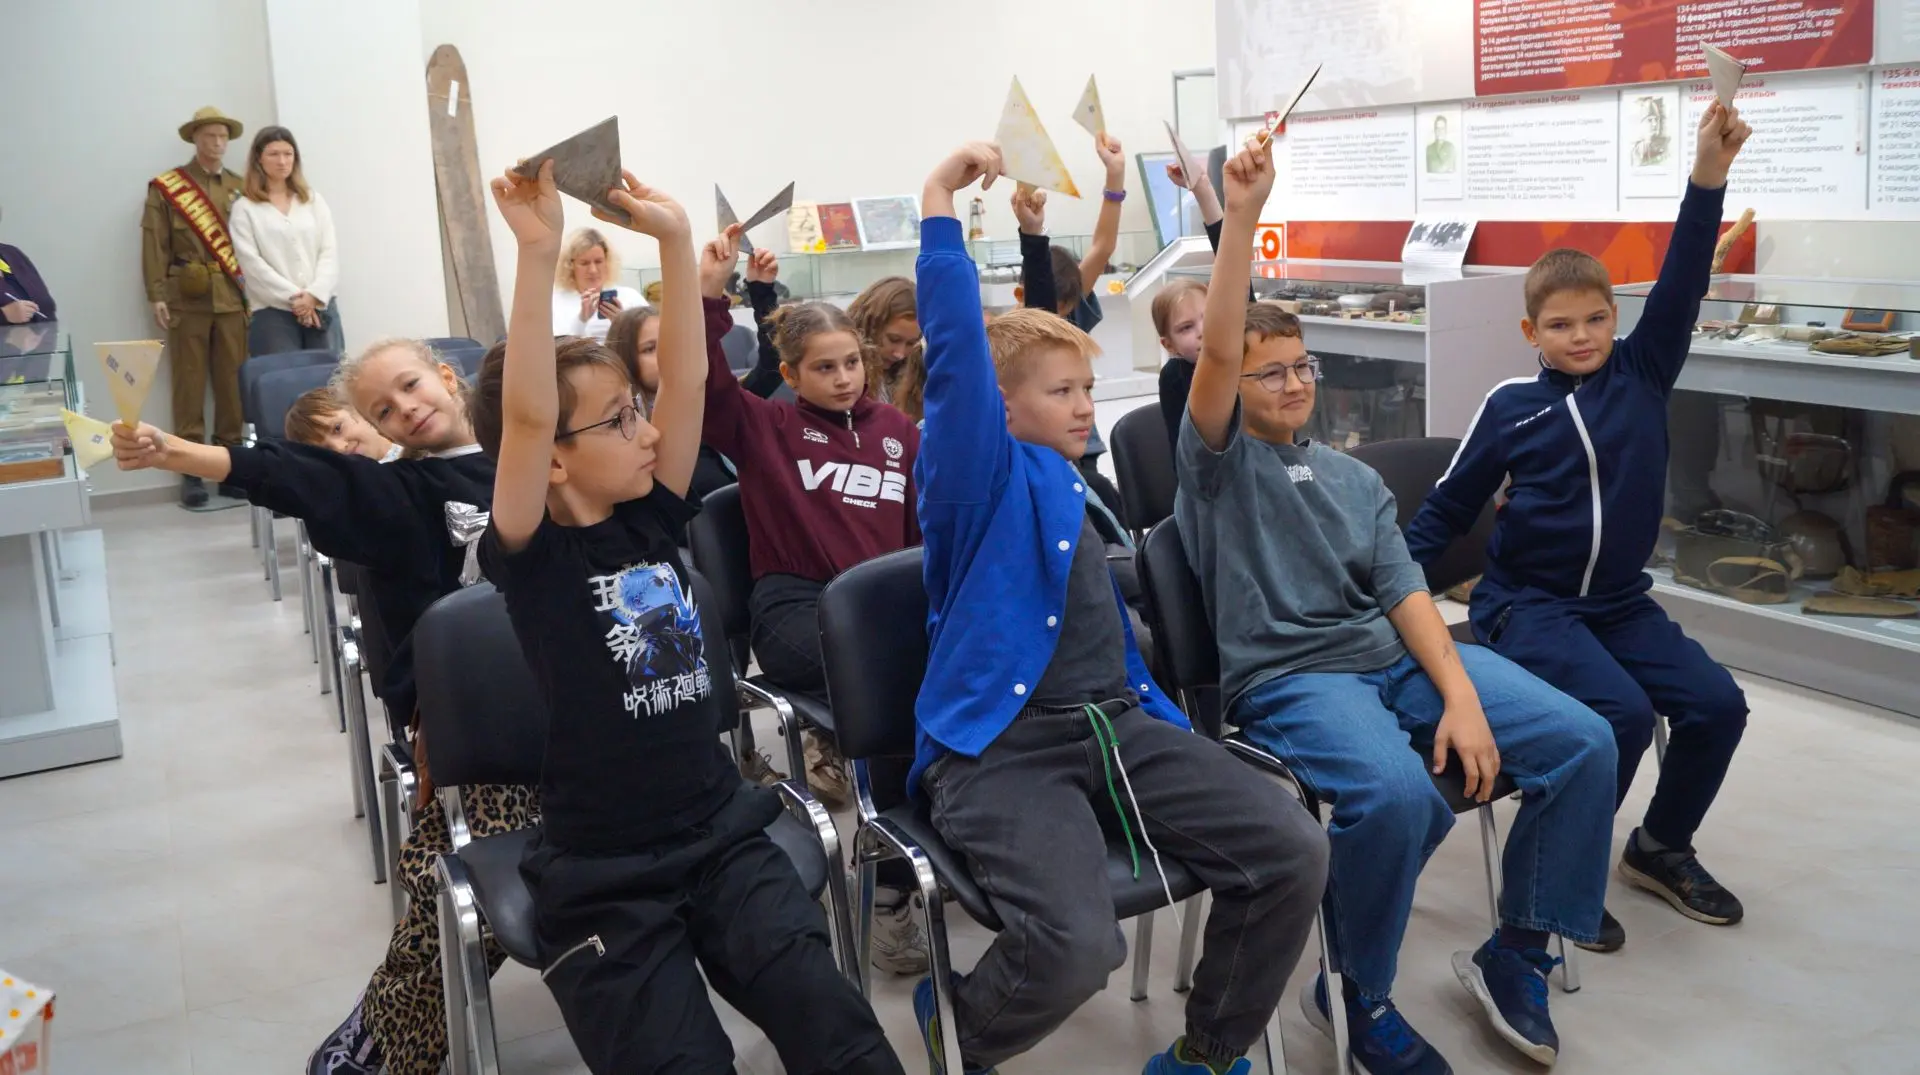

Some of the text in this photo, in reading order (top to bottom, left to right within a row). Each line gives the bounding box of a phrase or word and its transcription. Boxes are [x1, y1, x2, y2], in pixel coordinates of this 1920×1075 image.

[1677, 3, 1696, 12] 134-й
[1698, 0, 1738, 11] отдельный
[1687, 10, 1721, 21] февраля
[1723, 8, 1741, 16] 1942
[1767, 3, 1803, 12] включен
[1540, 18, 1556, 26] было
[1682, 23, 1706, 31] состав
[1707, 20, 1724, 28] 24-й
[1724, 16, 1766, 28] отдельной
[1768, 12, 1805, 22] танковой
[1806, 8, 1843, 19] бригады.
[1496, 35, 1510, 43] дней
[1553, 26, 1603, 37] наступательных
[1604, 23, 1621, 31] боев
[1677, 30, 1714, 41] Батальону
[1715, 28, 1730, 37] был
[1731, 25, 1770, 36] присвоен
[1771, 23, 1797, 32] номер
[1798, 20, 1815, 29] 276,
[1823, 19, 1835, 27] до
[1520, 40, 1544, 49] бригада
[1546, 36, 1583, 47] освободила
[1676, 42, 1698, 51] конца
[1732, 32, 1792, 45] Отечественной
[1793, 29, 1820, 38] войны
[1822, 28, 1833, 36] он
[1592, 50, 1622, 59] большой
[1882, 67, 1912, 78] 135-й
[1689, 82, 1713, 91] 134-й
[1881, 82, 1920, 90] танков
[1550, 94, 1580, 102] бригада
[797, 459, 906, 504] VIBE
[842, 497, 877, 508] CHECK
